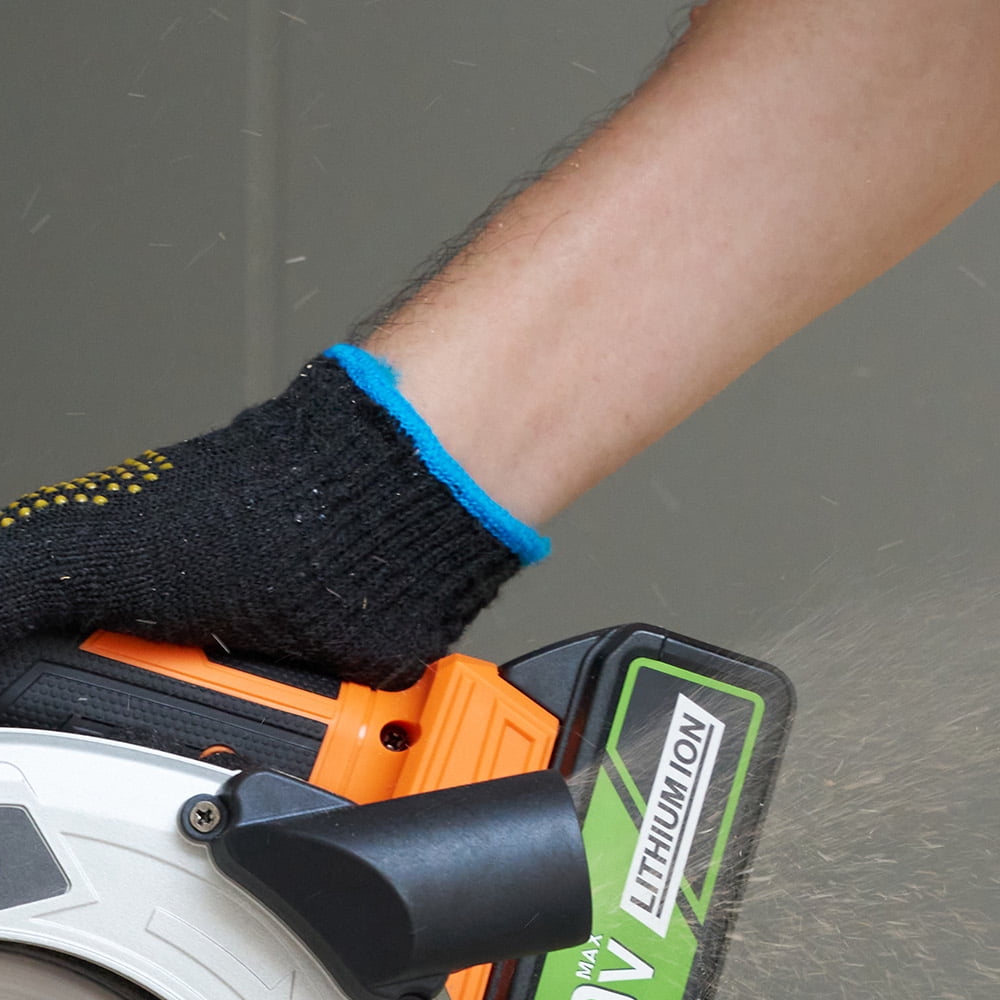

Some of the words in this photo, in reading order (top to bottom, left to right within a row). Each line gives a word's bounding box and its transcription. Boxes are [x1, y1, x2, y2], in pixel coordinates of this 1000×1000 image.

[630, 776, 689, 913] LITHIUM
[669, 713, 707, 778] ION
[576, 934, 603, 980] MAX
